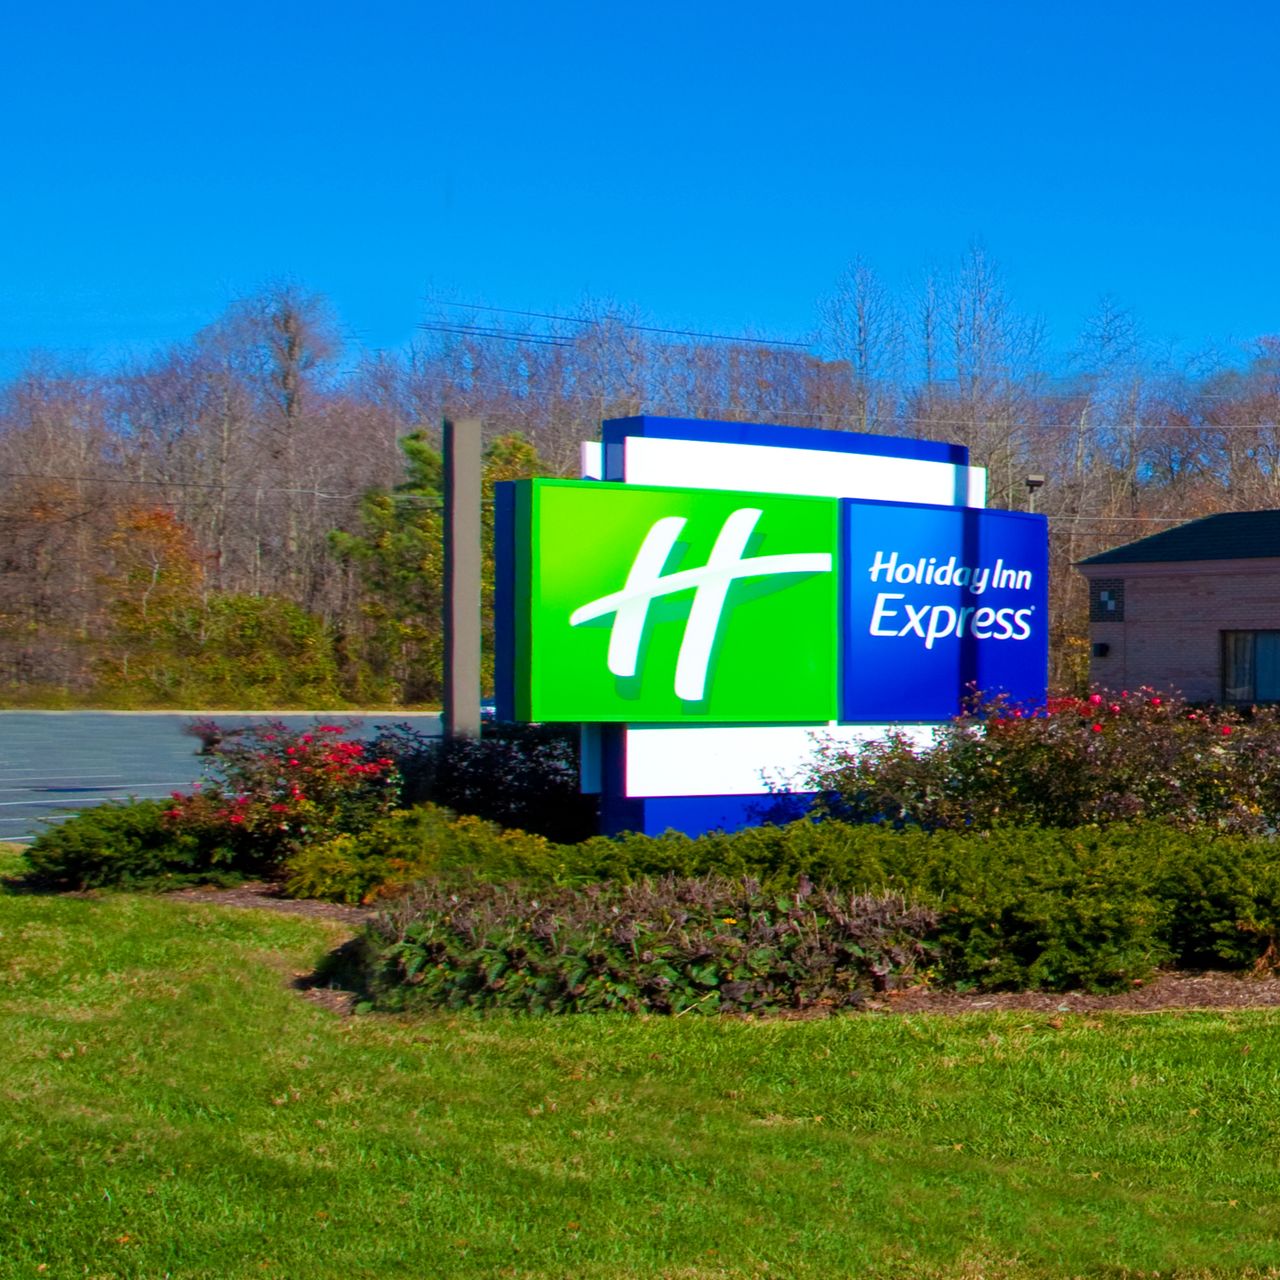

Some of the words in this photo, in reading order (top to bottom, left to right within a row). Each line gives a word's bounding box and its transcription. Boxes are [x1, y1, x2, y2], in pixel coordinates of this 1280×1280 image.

[868, 551, 990, 595] Holiday
[991, 558, 1032, 590] Inn
[869, 592, 1033, 650] Express
